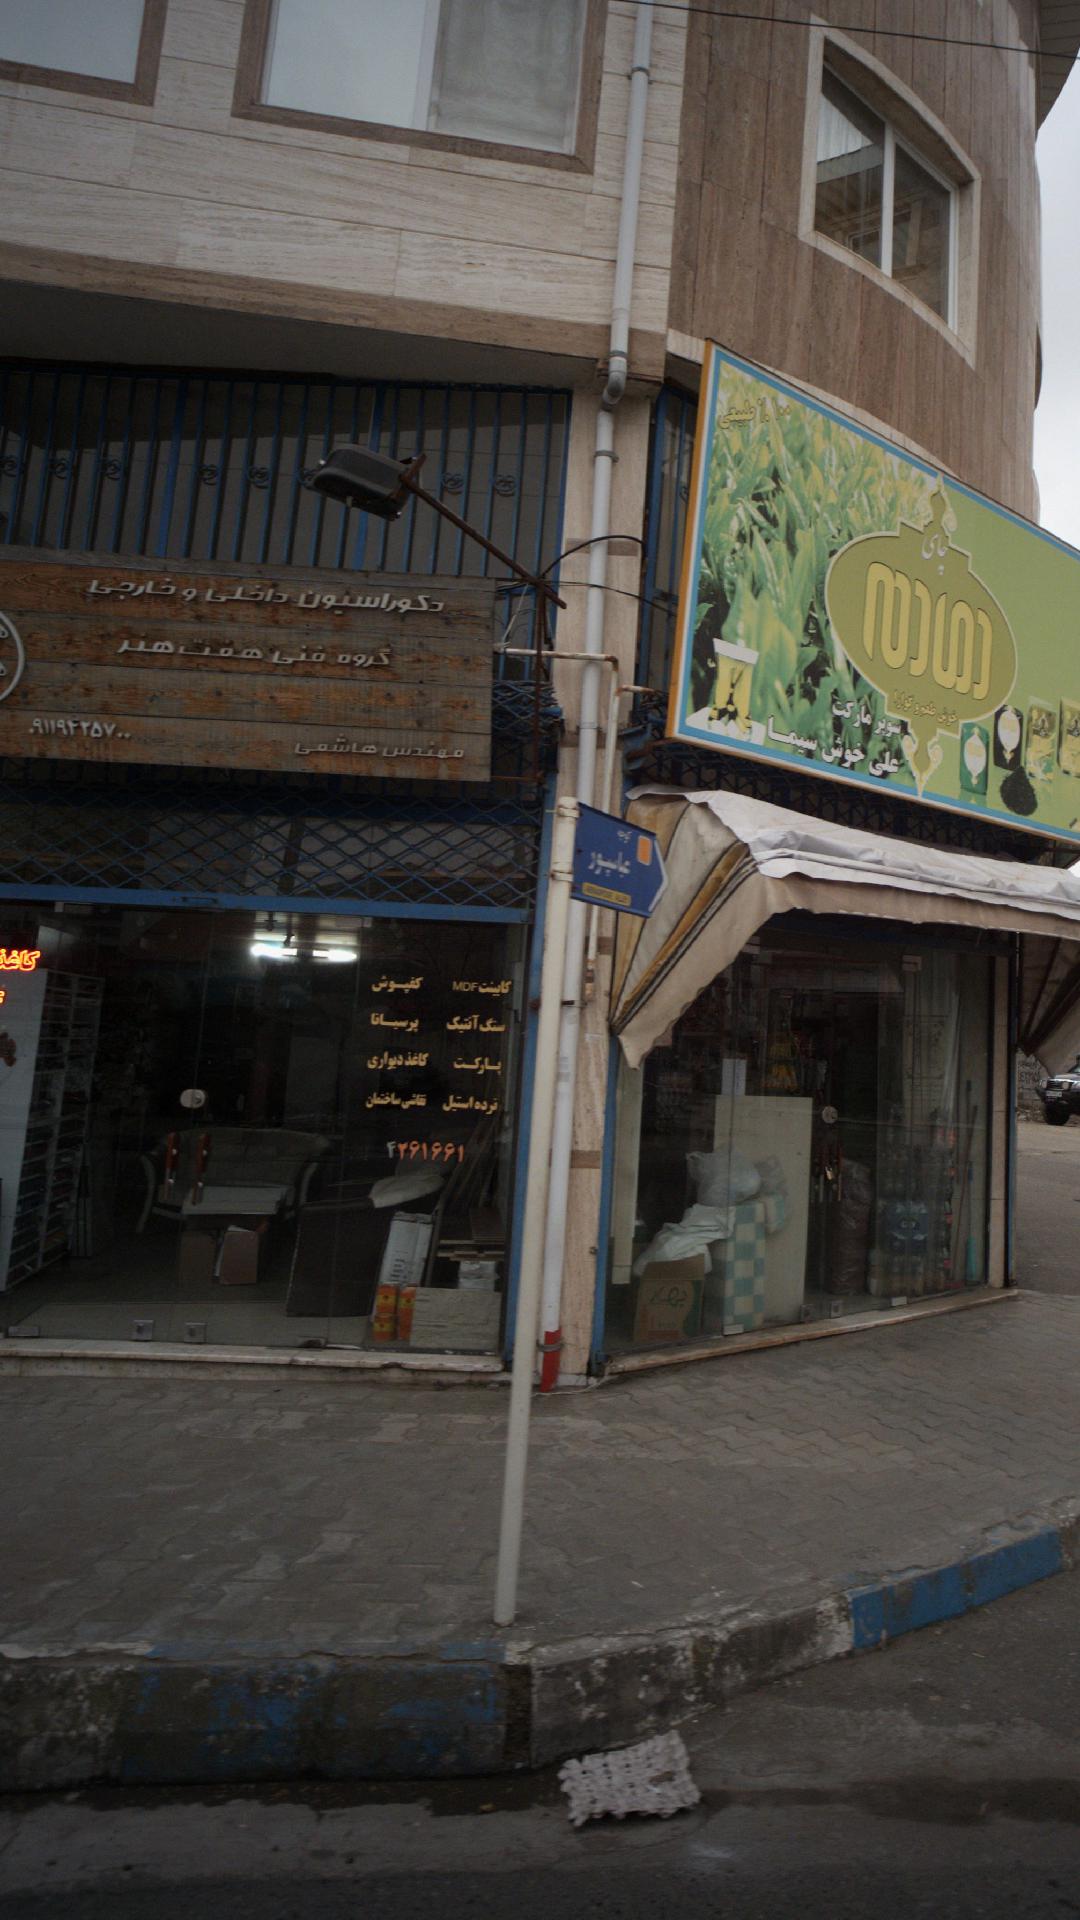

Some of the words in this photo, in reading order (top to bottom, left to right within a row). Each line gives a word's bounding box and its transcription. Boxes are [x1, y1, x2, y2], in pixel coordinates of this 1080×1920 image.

[921, 533, 948, 575] چای
[88, 578, 176, 600] خارجی
[181, 588, 197, 601] و
[205, 585, 289, 603] داخلی
[297, 590, 444, 615] دکوراسیون
[116, 635, 175, 654] هنر
[177, 637, 262, 660] هفت
[271, 645, 325, 664] فنی
[336, 647, 392, 668] گروه
[768, 716, 817, 754] سیما
[875, 718, 902, 737] سوپر
[294, 733, 376, 754] هاشمی
[382, 741, 465, 759] مهندس
[822, 737, 865, 768] خوش
[869, 751, 899, 776] علی
[371, 975, 424, 994] کفپوش
[452, 980, 478, 993] MDF
[478, 979, 512, 996] کابینت
[446, 1014, 480, 1034] آنتیک
[479, 1016, 506, 1032] سنگ
[367, 1050, 404, 1071] دیواری
[404, 1050, 430, 1067] کاغذ
[453, 1056, 503, 1076] پارکت
[365, 1091, 401, 1109] ساختمان
[401, 1092, 428, 1110] نقاشی
[442, 1094, 474, 1112] استیل
